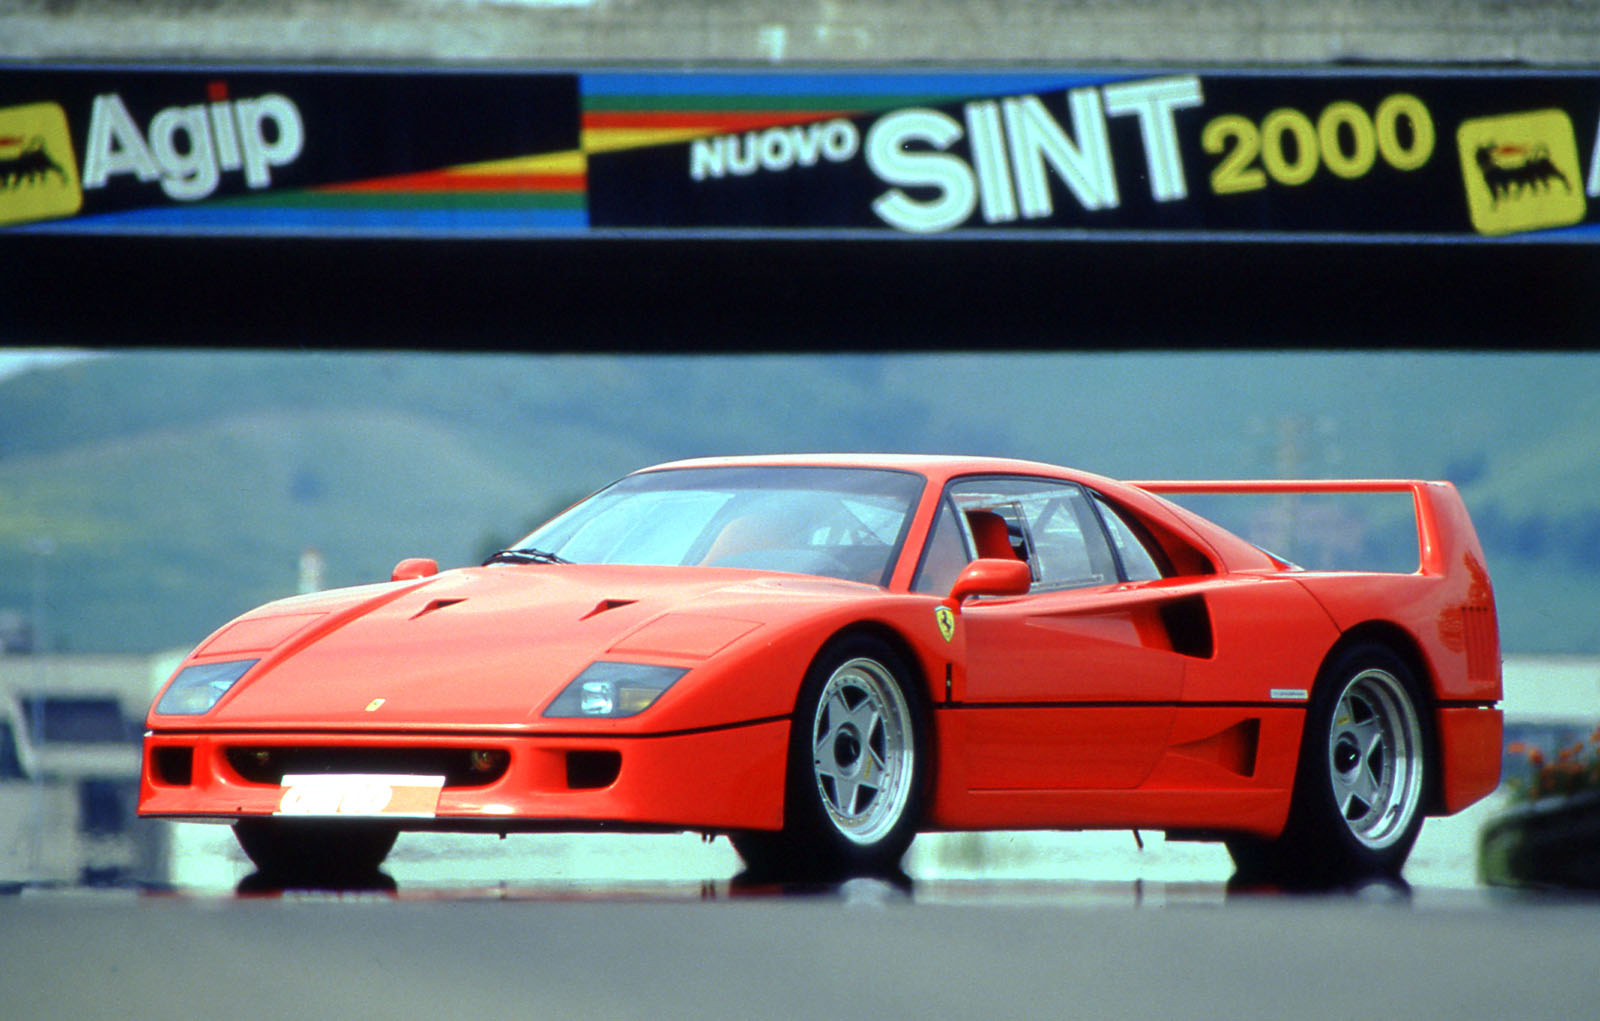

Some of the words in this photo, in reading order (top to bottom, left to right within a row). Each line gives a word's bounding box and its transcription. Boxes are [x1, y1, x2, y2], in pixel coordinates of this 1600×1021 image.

[83, 82, 304, 200] Agip
[690, 119, 860, 180] NUOVO
[865, 75, 1204, 233] SINT
[1202, 93, 1436, 195] 2000
